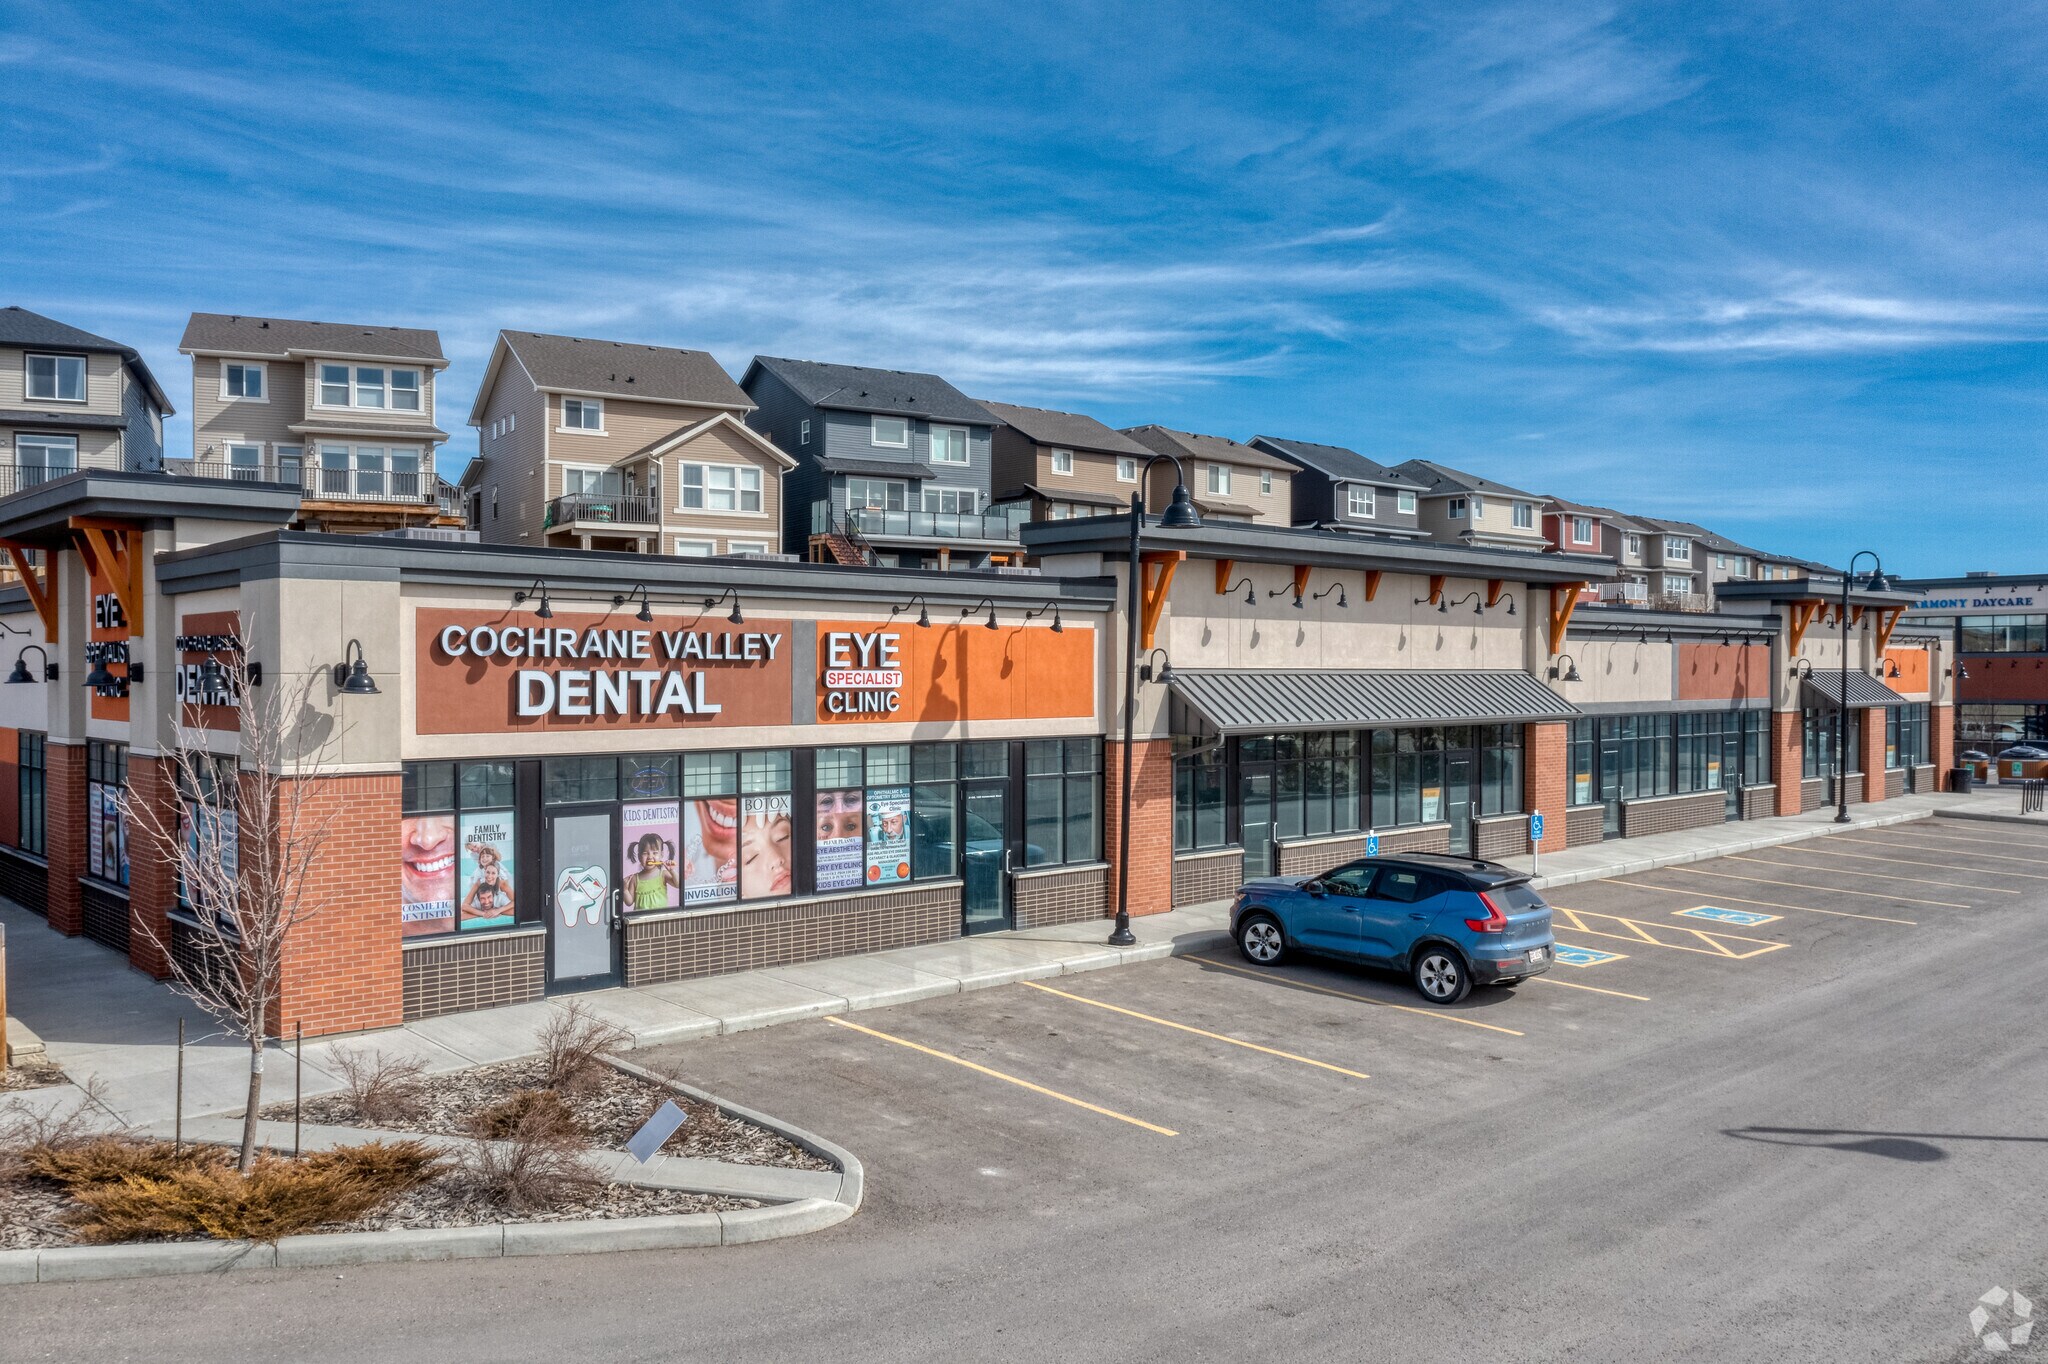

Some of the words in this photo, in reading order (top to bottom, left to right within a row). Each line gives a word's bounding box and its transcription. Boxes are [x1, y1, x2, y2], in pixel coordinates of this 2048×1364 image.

[1972, 597, 2033, 607] DAYCARE
[95, 593, 119, 628] EYE
[441, 625, 651, 659] COCHRANE
[661, 630, 782, 660] VALLEY
[829, 632, 901, 667] EYE
[828, 672, 900, 685] SPECIALIST
[518, 670, 722, 717] DENTAL
[828, 691, 900, 713] CLINIC
[744, 797, 789, 811] BOTOX
[623, 808, 642, 821] KIDS
[643, 806, 679, 820] DENTISTRY
[474, 824, 500, 834] FAMILY
[468, 832, 507, 842] DENTISTRY
[816, 847, 828, 855] EYE
[828, 845, 863, 853] AESTHETICS
[816, 864, 829, 872] DRY
[843, 861, 863, 869] CLINIC
[685, 887, 737, 900] INVISALIGN
[403, 900, 451, 912] COSMETIC
